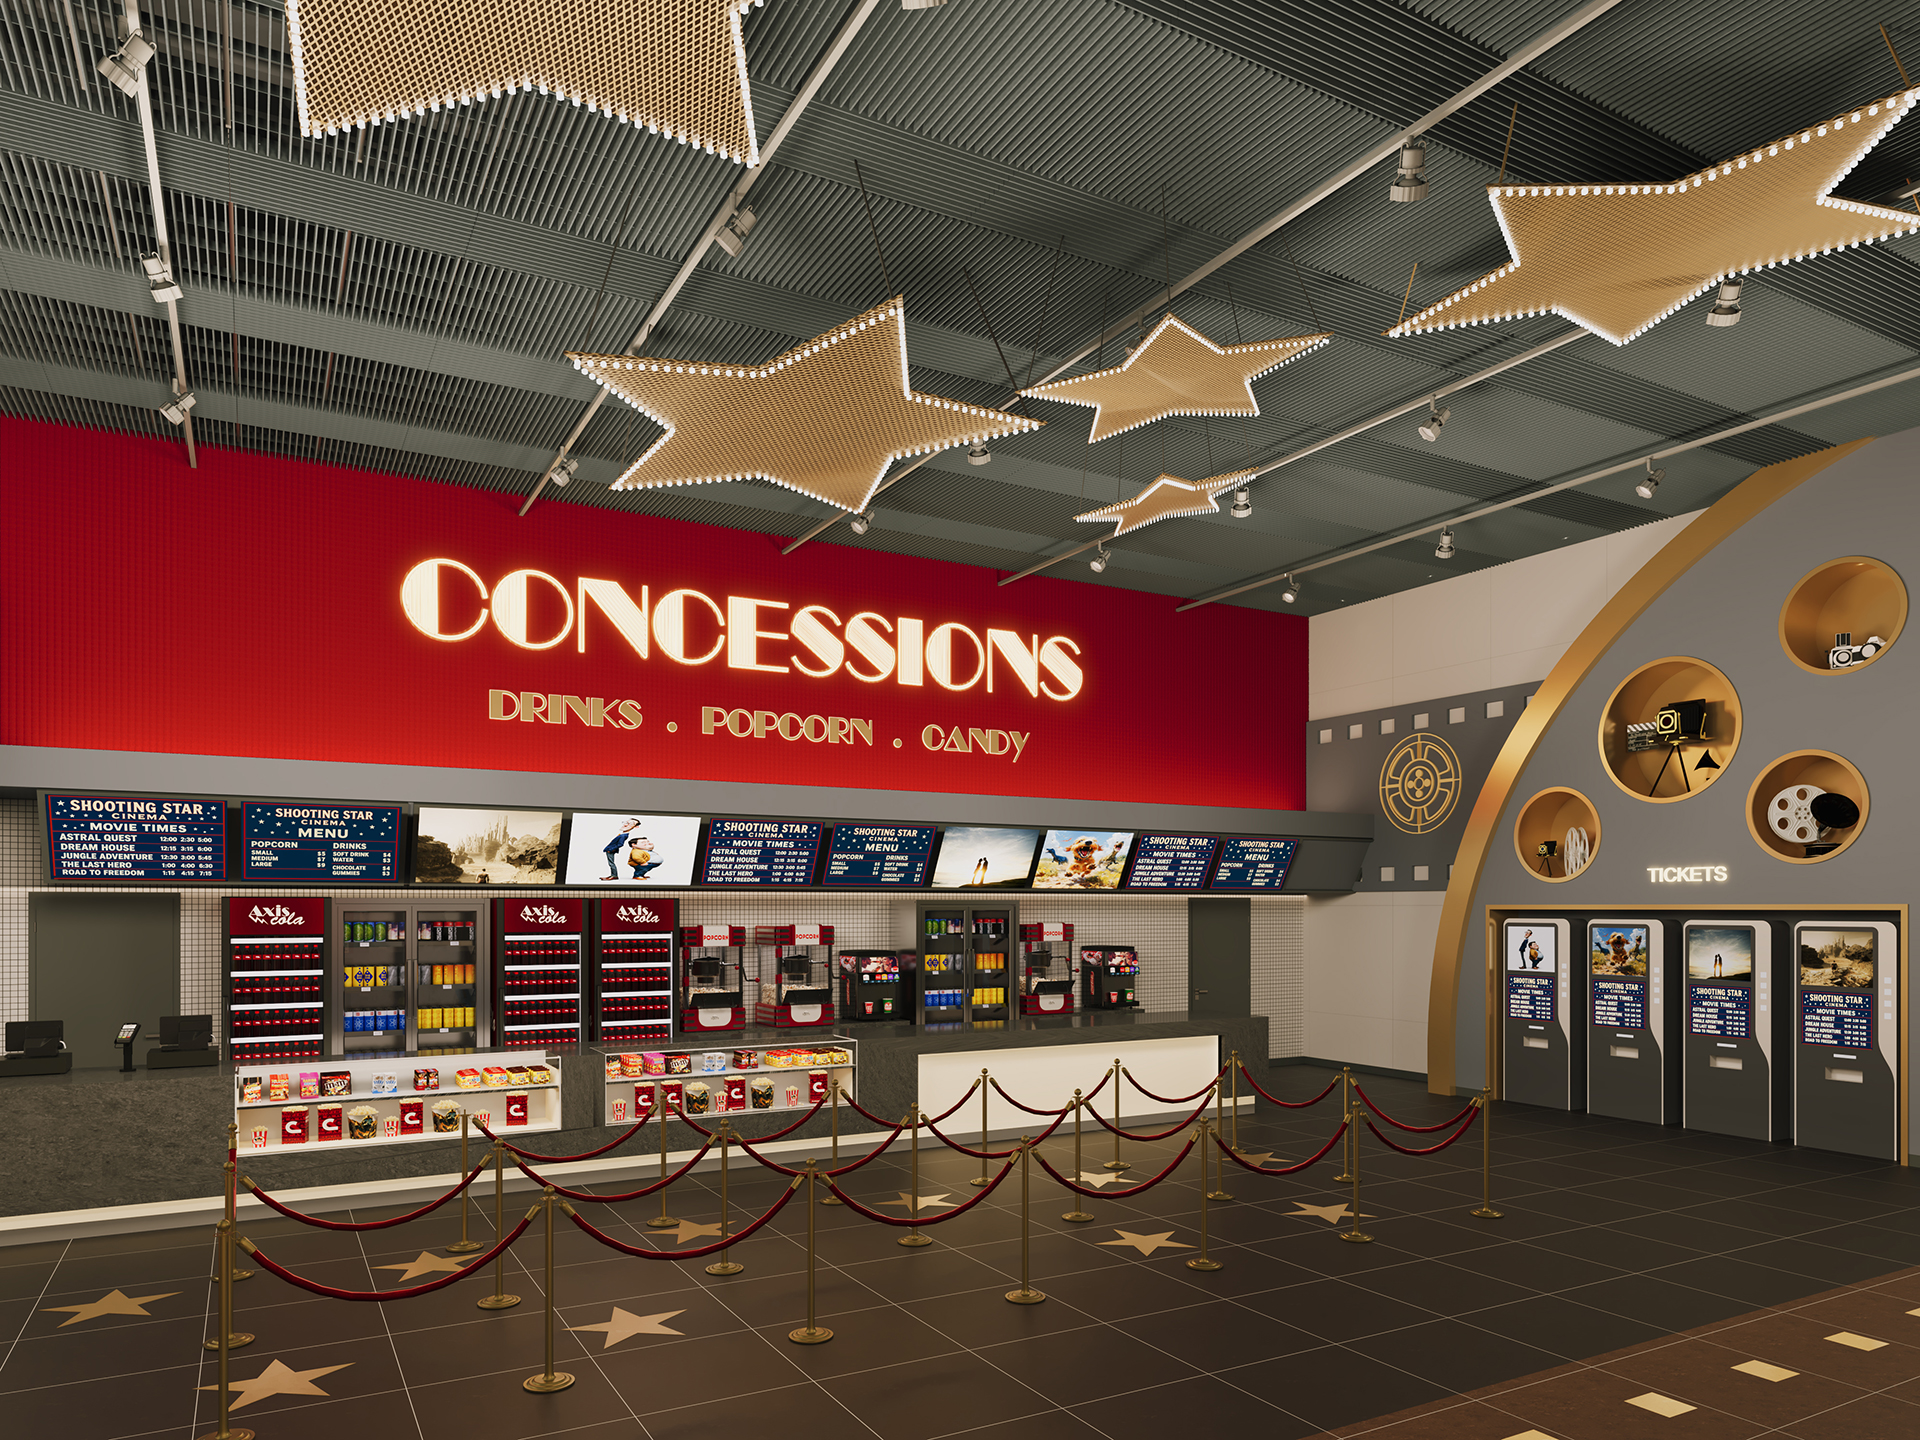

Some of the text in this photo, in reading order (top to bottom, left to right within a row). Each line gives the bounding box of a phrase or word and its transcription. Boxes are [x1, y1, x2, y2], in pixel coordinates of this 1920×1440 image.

[400, 558, 1083, 701] CONCESSIONS
[489, 689, 1030, 763] DRINKS POPCORN CANDY
[70, 800, 203, 814] SHOOTING STAR
[276, 808, 373, 820] SHOOTING STAR
[90, 823, 186, 832] MOVIE TIMES
[298, 828, 348, 838] MENU
[724, 822, 808, 833] SHOOTING STAR
[854, 828, 918, 837] SHOOTING STAR
[60, 833, 101, 841] ASTRAL
[104, 834, 137, 842] QUEST
[1149, 837, 1208, 846] SHOOTING STAR
[61, 843, 98, 851] DREAM
[865, 843, 899, 852] MENU
[1647, 866, 1727, 882] TICKETS
[249, 905, 290, 917] Axis
[521, 905, 555, 916] Axis
[617, 905, 649, 916] Axis
[270, 912, 305, 925] cola
[538, 911, 567, 924] cola
[633, 911, 660, 923] cola
[1696, 988, 1742, 997] SHOOTING STAR
[1810, 994, 1863, 1004] SHOOTING STAR
